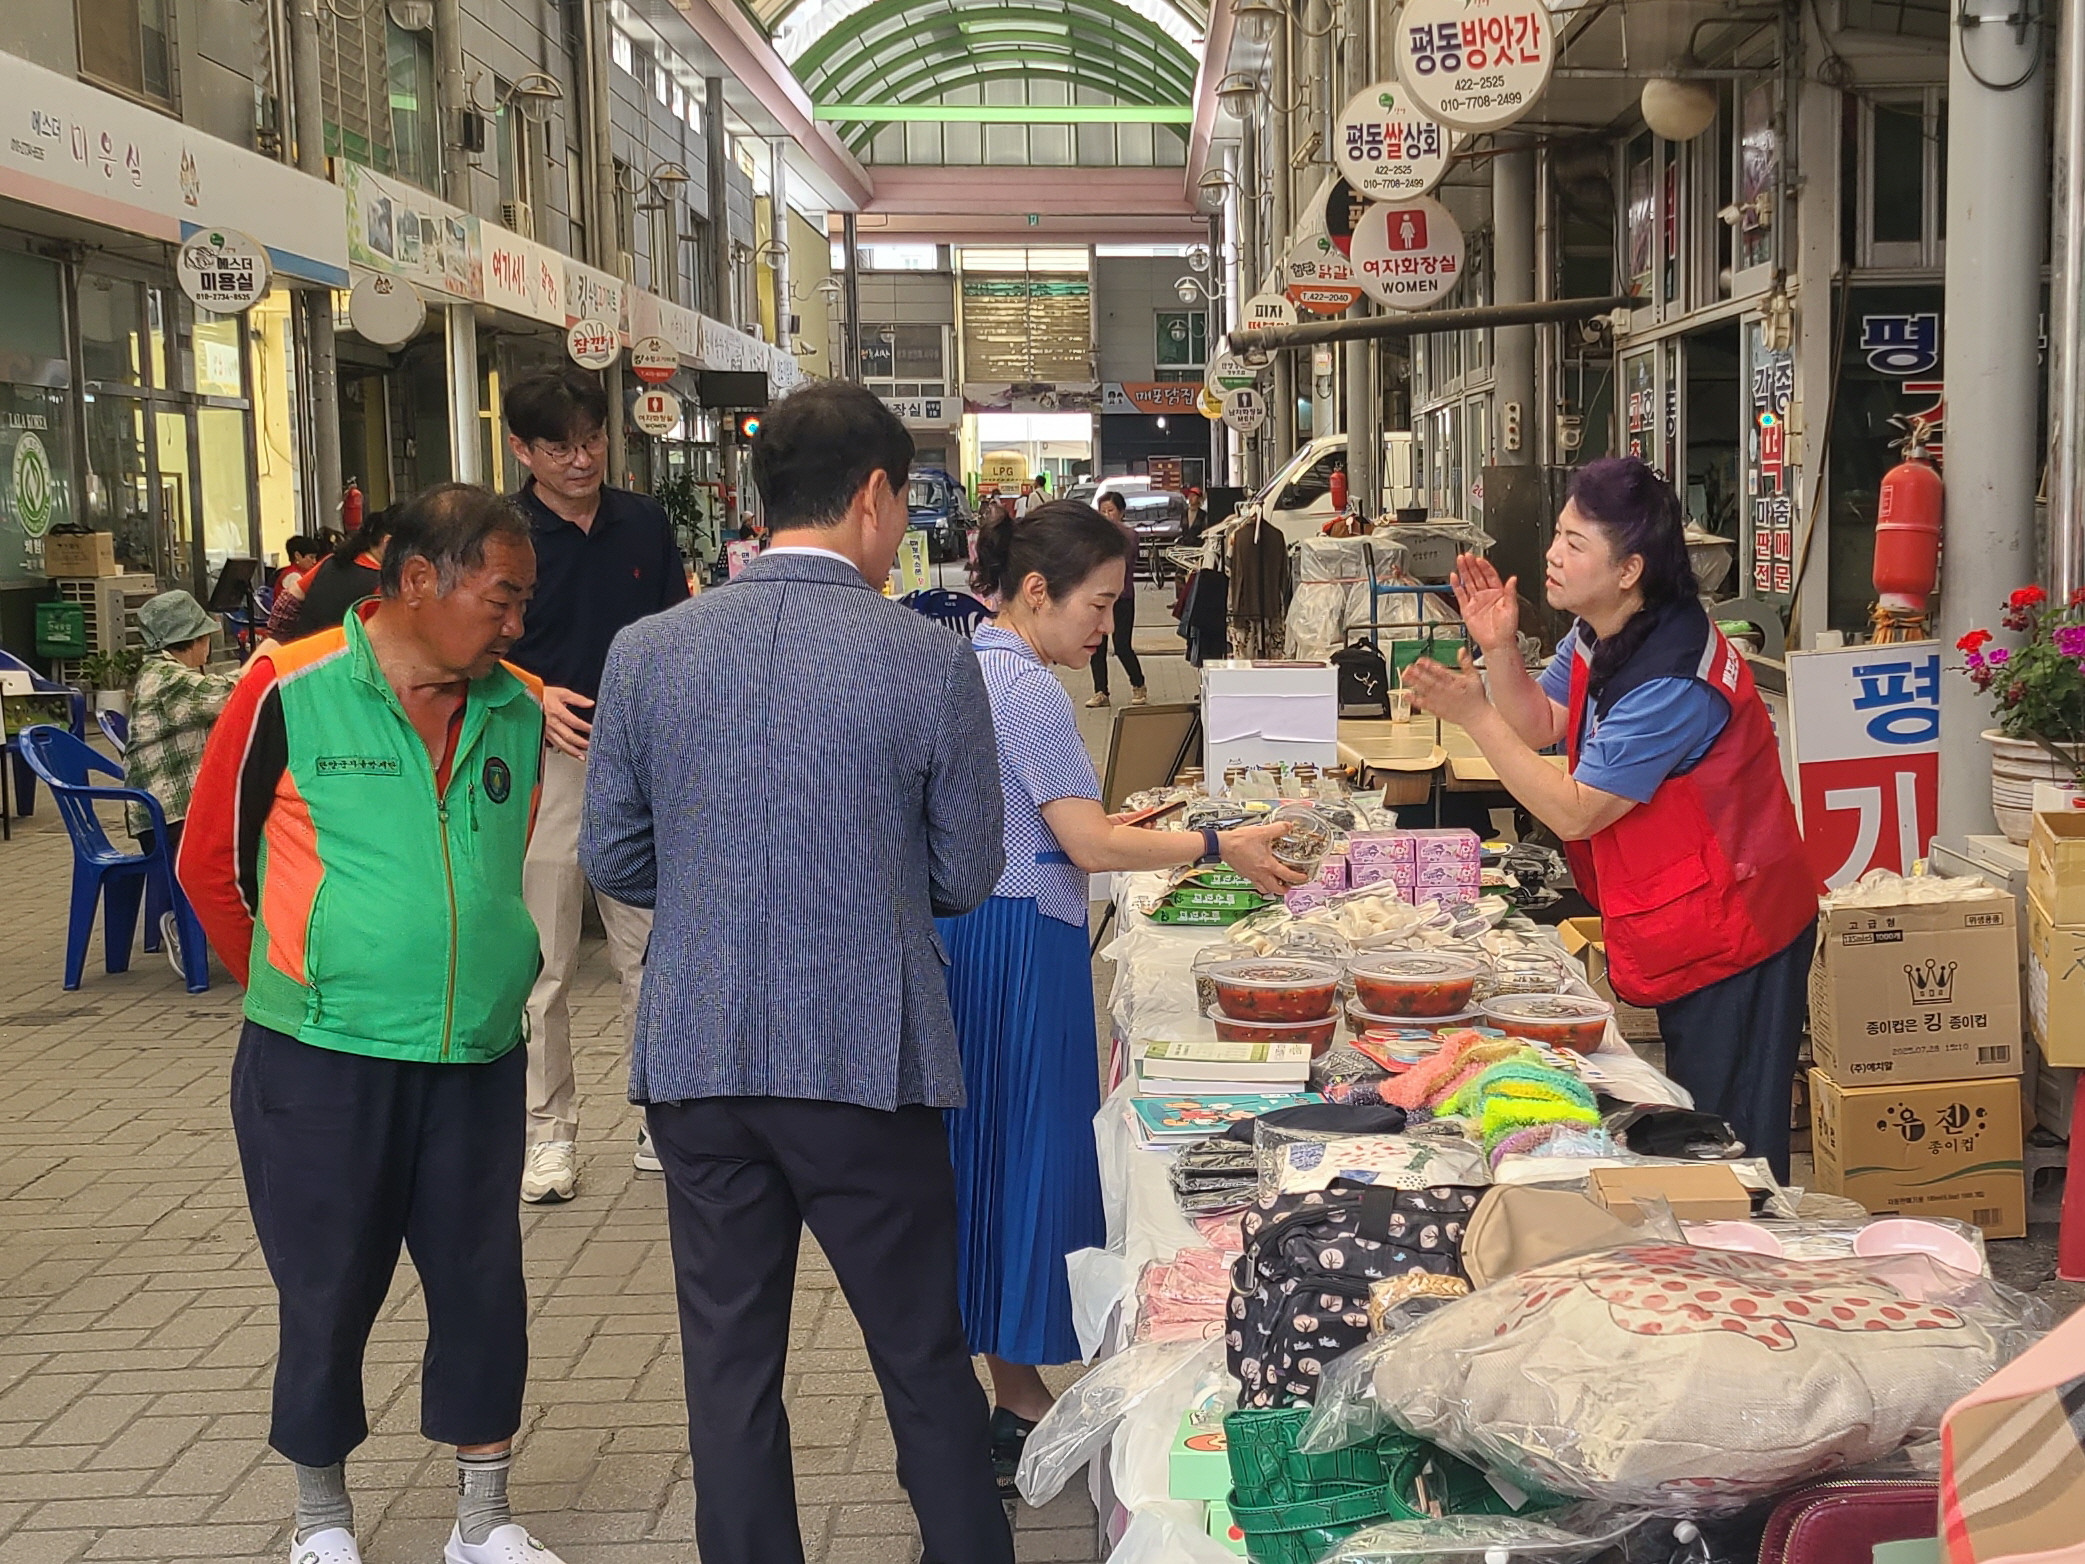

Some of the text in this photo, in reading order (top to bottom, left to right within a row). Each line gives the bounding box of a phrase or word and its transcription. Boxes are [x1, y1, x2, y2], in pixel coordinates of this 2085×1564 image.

[1409, 12, 1541, 76] 평동방앗간
[1454, 75, 1505, 92] 422-2525
[1440, 92, 1522, 112] 010-7708-2499
[1346, 122, 1441, 161] 평동쌀상회
[70, 122, 143, 188] 미용실
[1374, 165, 1413, 175] 422-2525
[1363, 179, 1424, 189] 010-7708-2499
[216, 257, 253, 271] 에스더
[1362, 254, 1457, 278] 여자화장실
[200, 272, 254, 292] 미용실
[1381, 279, 1438, 293] WOMEN
[1254, 304, 1283, 318] 피자
[573, 336, 615, 355] 잠깐!
[993, 466, 1013, 476] LPG
[1756, 530, 1790, 562] 판매
[1754, 562, 1791, 594] 전문
[1865, 1012, 1988, 1035] 종이컵은 킹 종이컵
[1927, 1137, 1974, 1155] 종이컵
